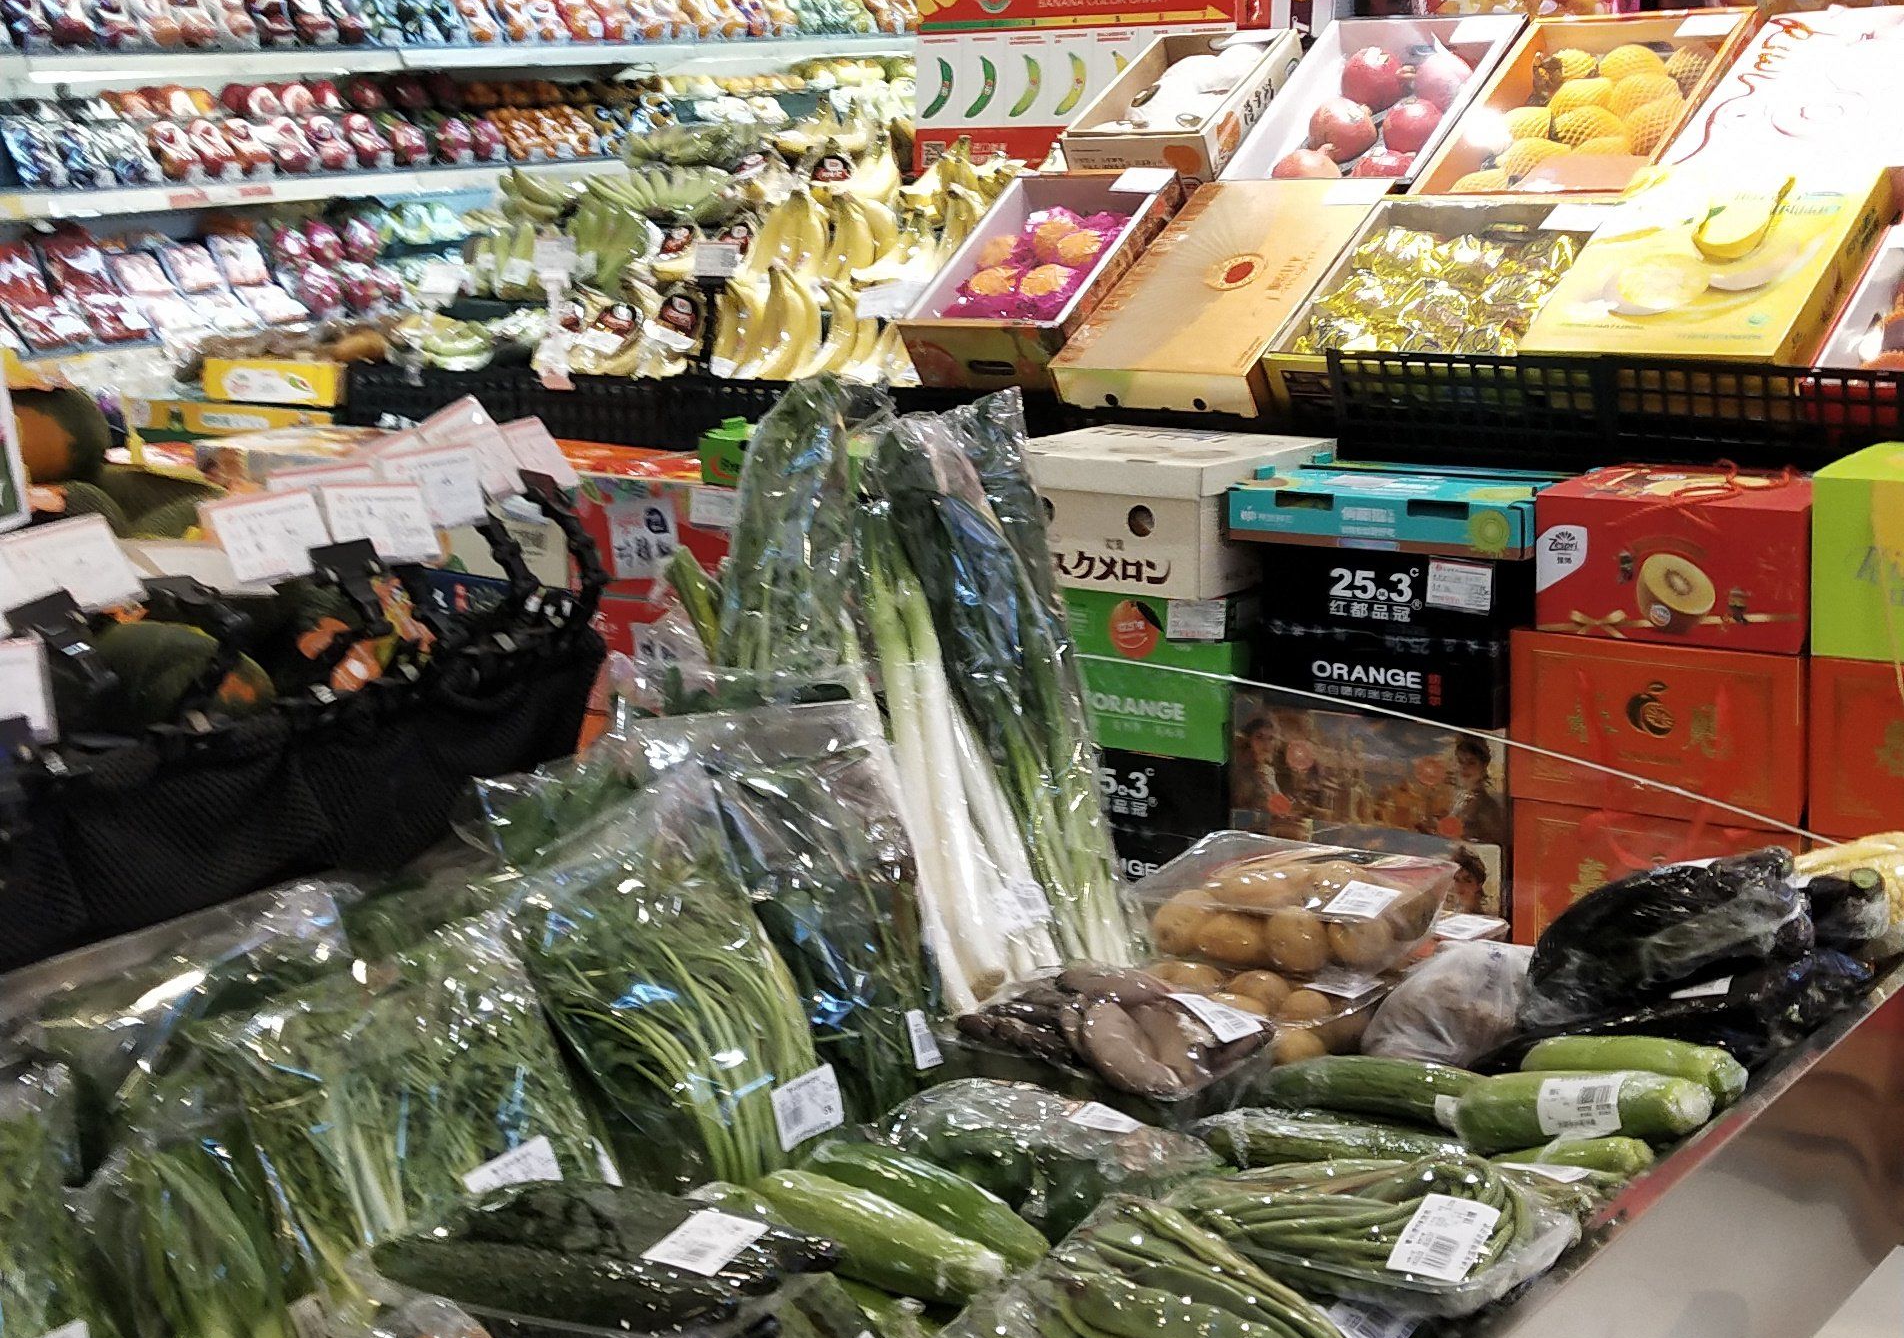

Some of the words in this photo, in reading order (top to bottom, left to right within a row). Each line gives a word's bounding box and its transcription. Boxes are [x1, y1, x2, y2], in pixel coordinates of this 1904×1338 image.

[1329, 599, 1411, 623] 红都品冠
[1312, 660, 1423, 689] ORANGE
[1092, 691, 1186, 721] ORANGE
